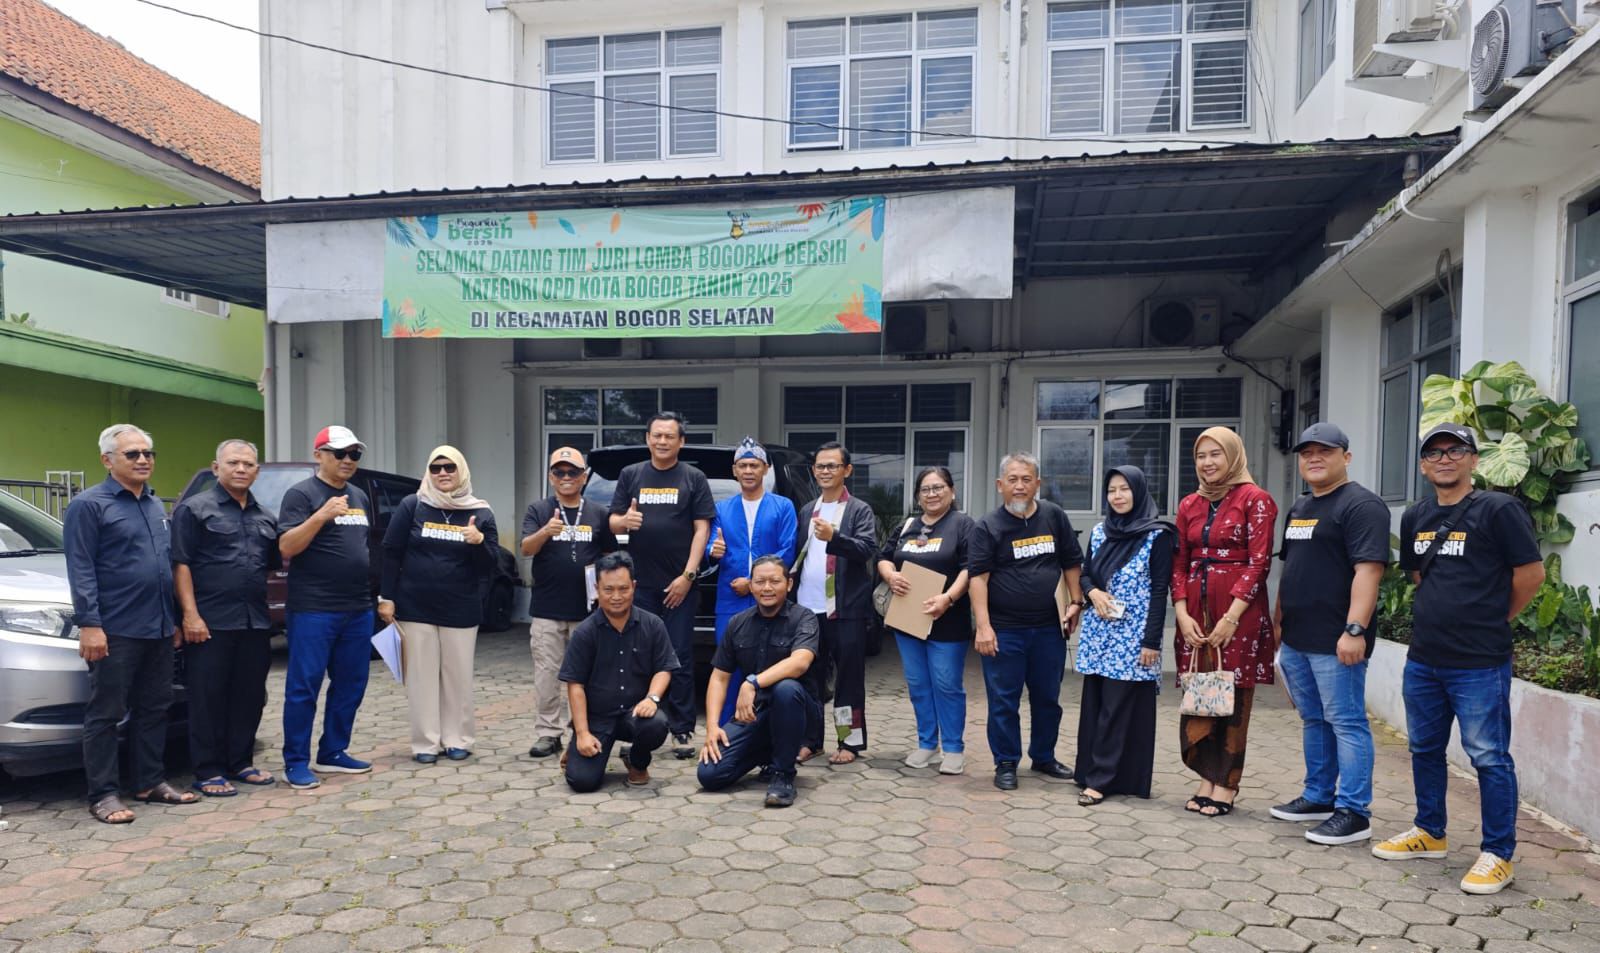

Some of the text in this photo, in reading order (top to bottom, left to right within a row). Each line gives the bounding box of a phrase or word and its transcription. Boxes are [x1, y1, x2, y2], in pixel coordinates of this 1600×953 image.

[448, 223, 513, 240] bersih
[416, 239, 847, 273] SELAMAT DATANG TIM JURI LOMBA BOGORKU BERSIH
[461, 272, 793, 300] KATEGORI OPD KOTA BOGOR TAHUN 2025
[471, 307, 774, 328] DI KECAMATAN BOGOR SELATAN
